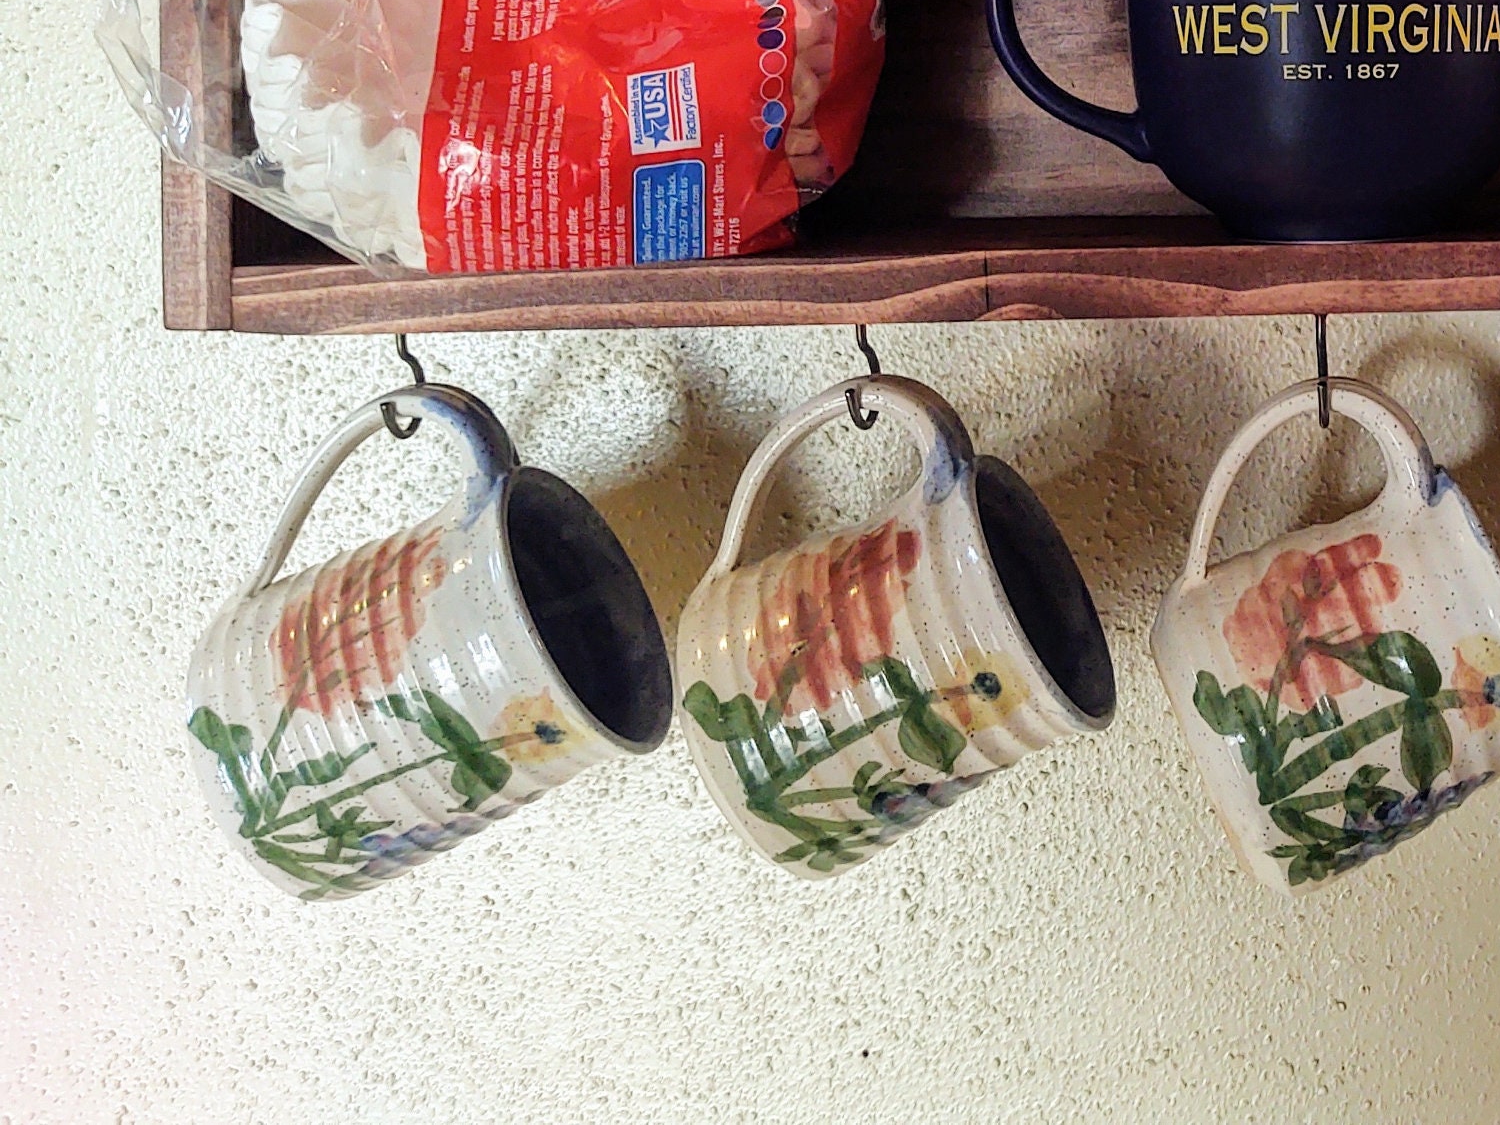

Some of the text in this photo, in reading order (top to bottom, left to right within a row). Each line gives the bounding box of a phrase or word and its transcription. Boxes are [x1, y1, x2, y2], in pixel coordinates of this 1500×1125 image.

[1173, 3, 1299, 55] WEST
[1283, 63, 1400, 80] EST. 1867
[643, 74, 666, 120] USA
[681, 67, 697, 140] Factory Certified
[631, 99, 644, 145] Assembled
[713, 160, 726, 193] Stores,
[713, 195, 724, 237] Wal-Mart
